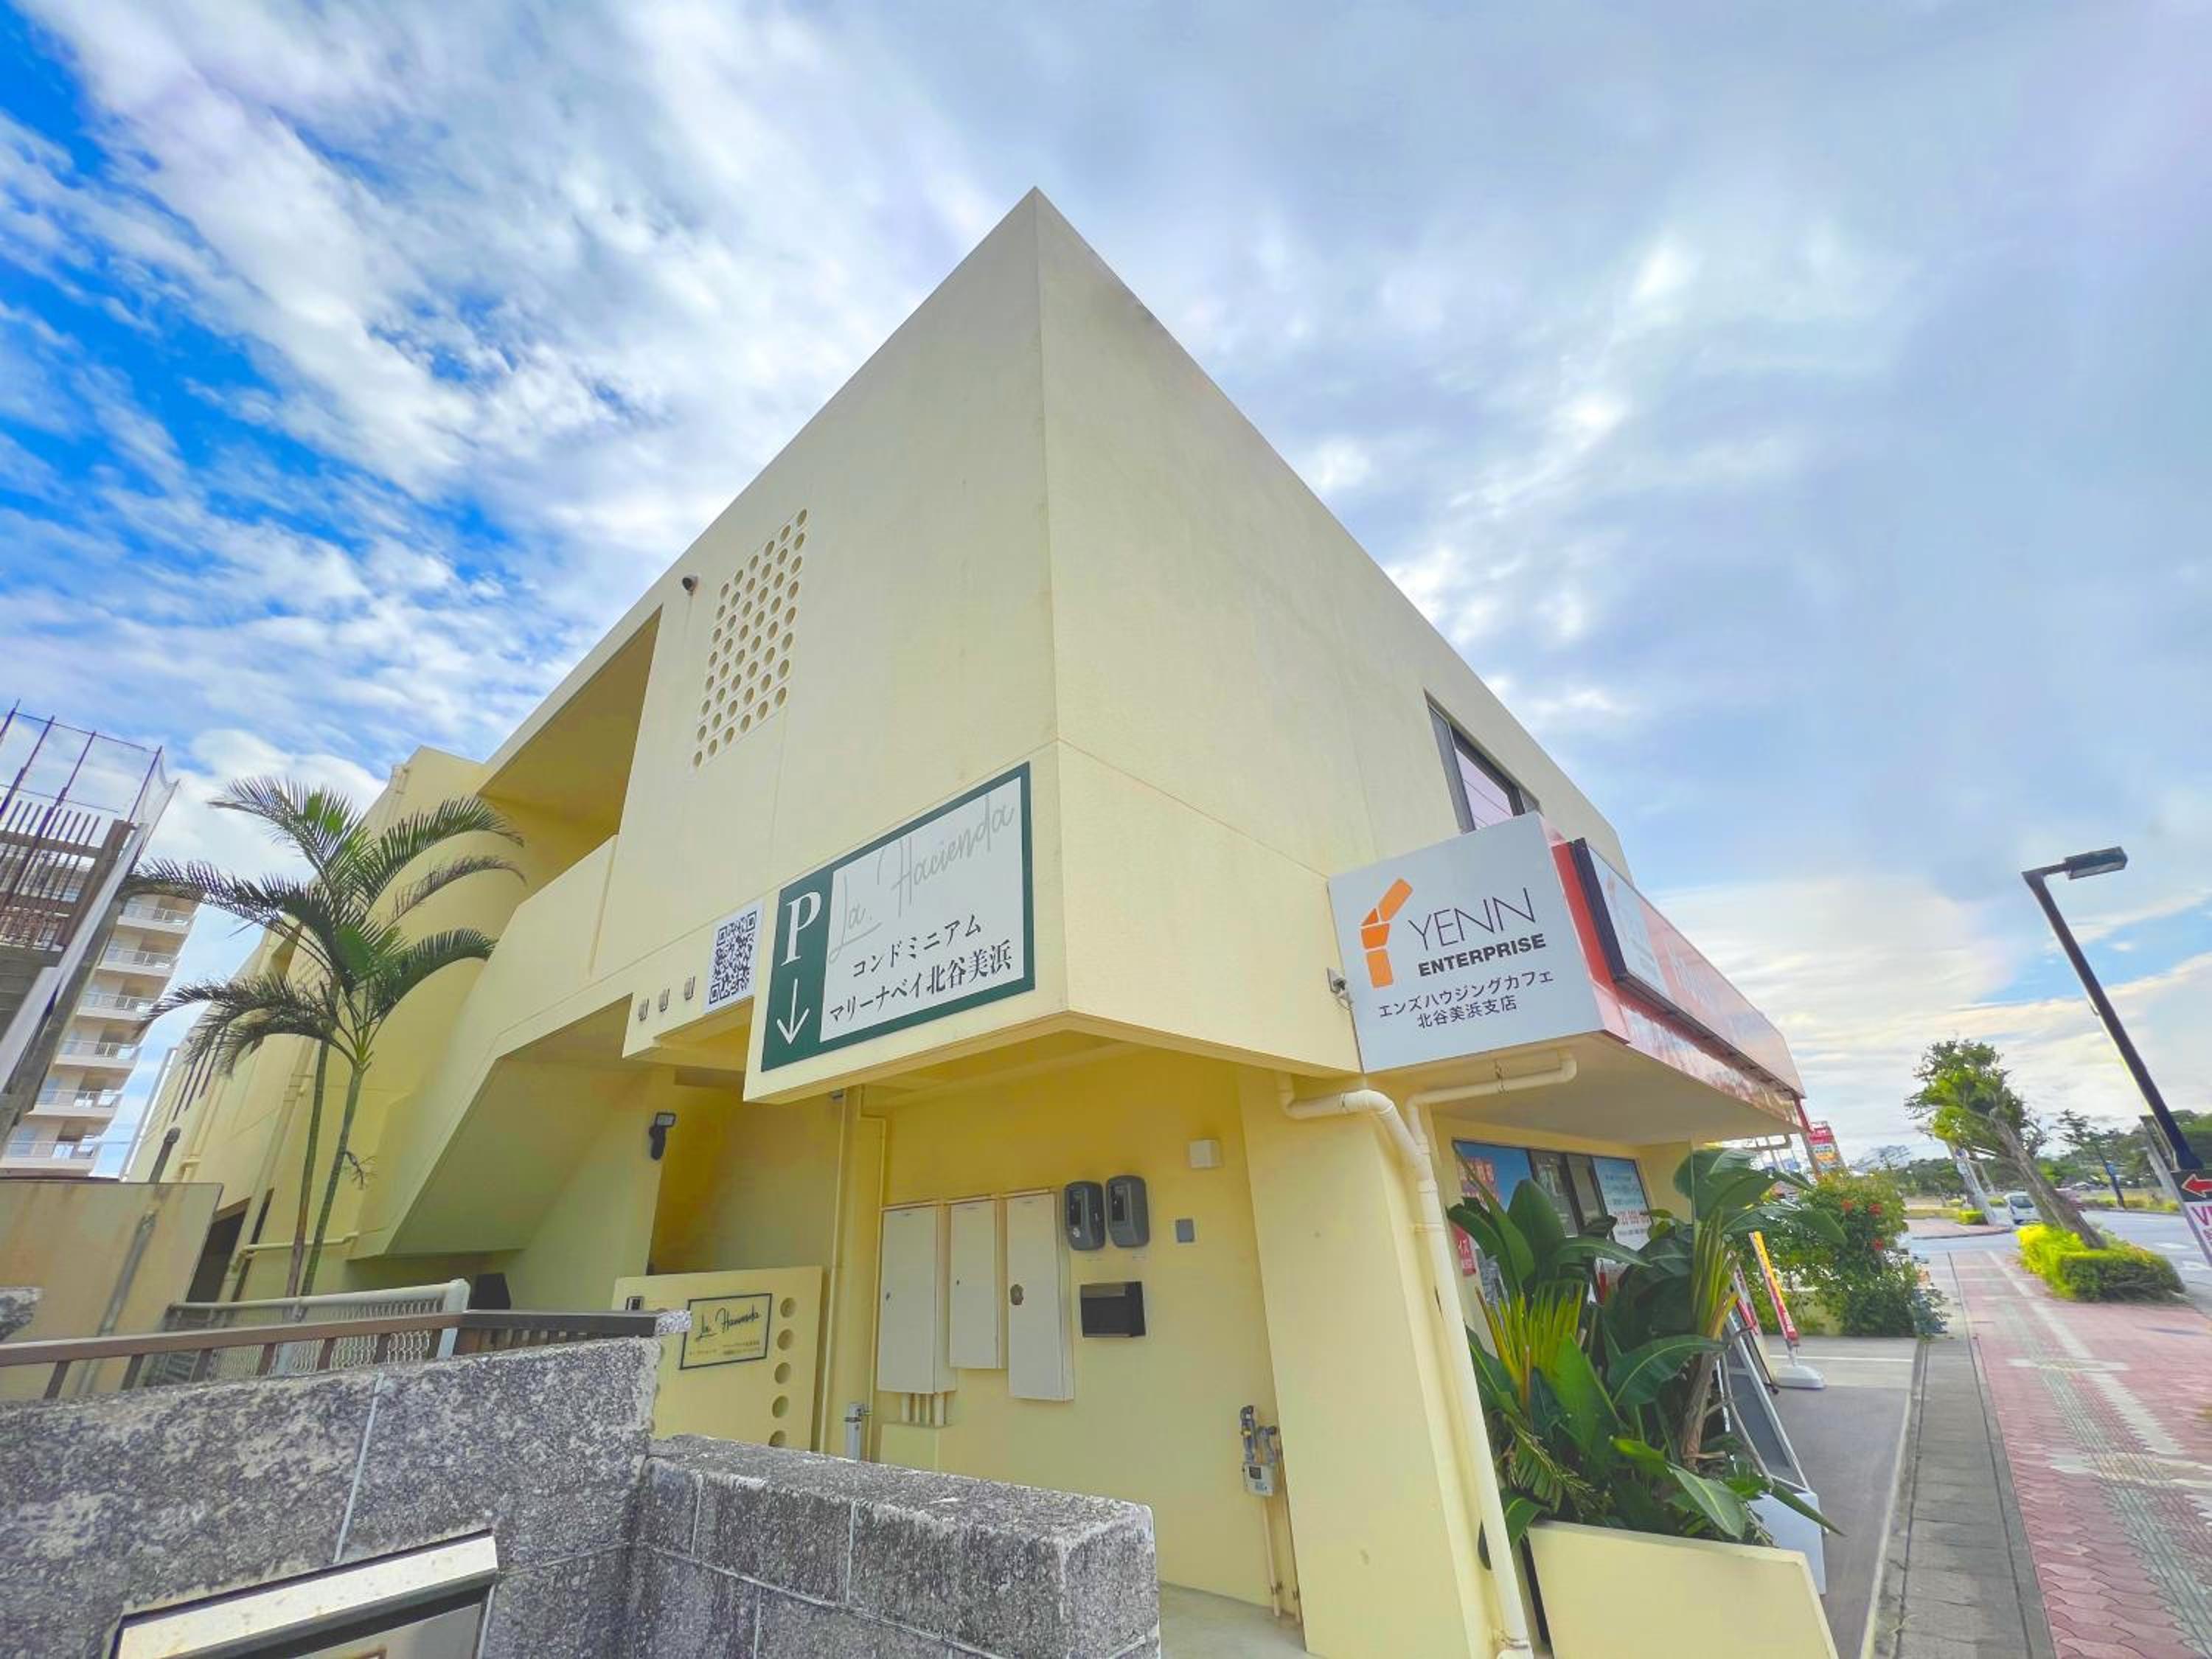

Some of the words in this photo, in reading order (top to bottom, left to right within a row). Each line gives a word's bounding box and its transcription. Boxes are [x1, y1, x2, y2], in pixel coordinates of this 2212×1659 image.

[877, 793, 1015, 917] Hacienda
[781, 891, 821, 967] P
[852, 914, 981, 978] コンドミニアム
[1407, 887, 1536, 951] YENN
[830, 939, 1012, 1022] マリーナベイ北谷美浜
[1417, 933, 1547, 977] ENTERPRISE
[1379, 970, 1554, 1018] エンズハウジングカフェ
[1416, 995, 1517, 1029] 北谷美浜支店
